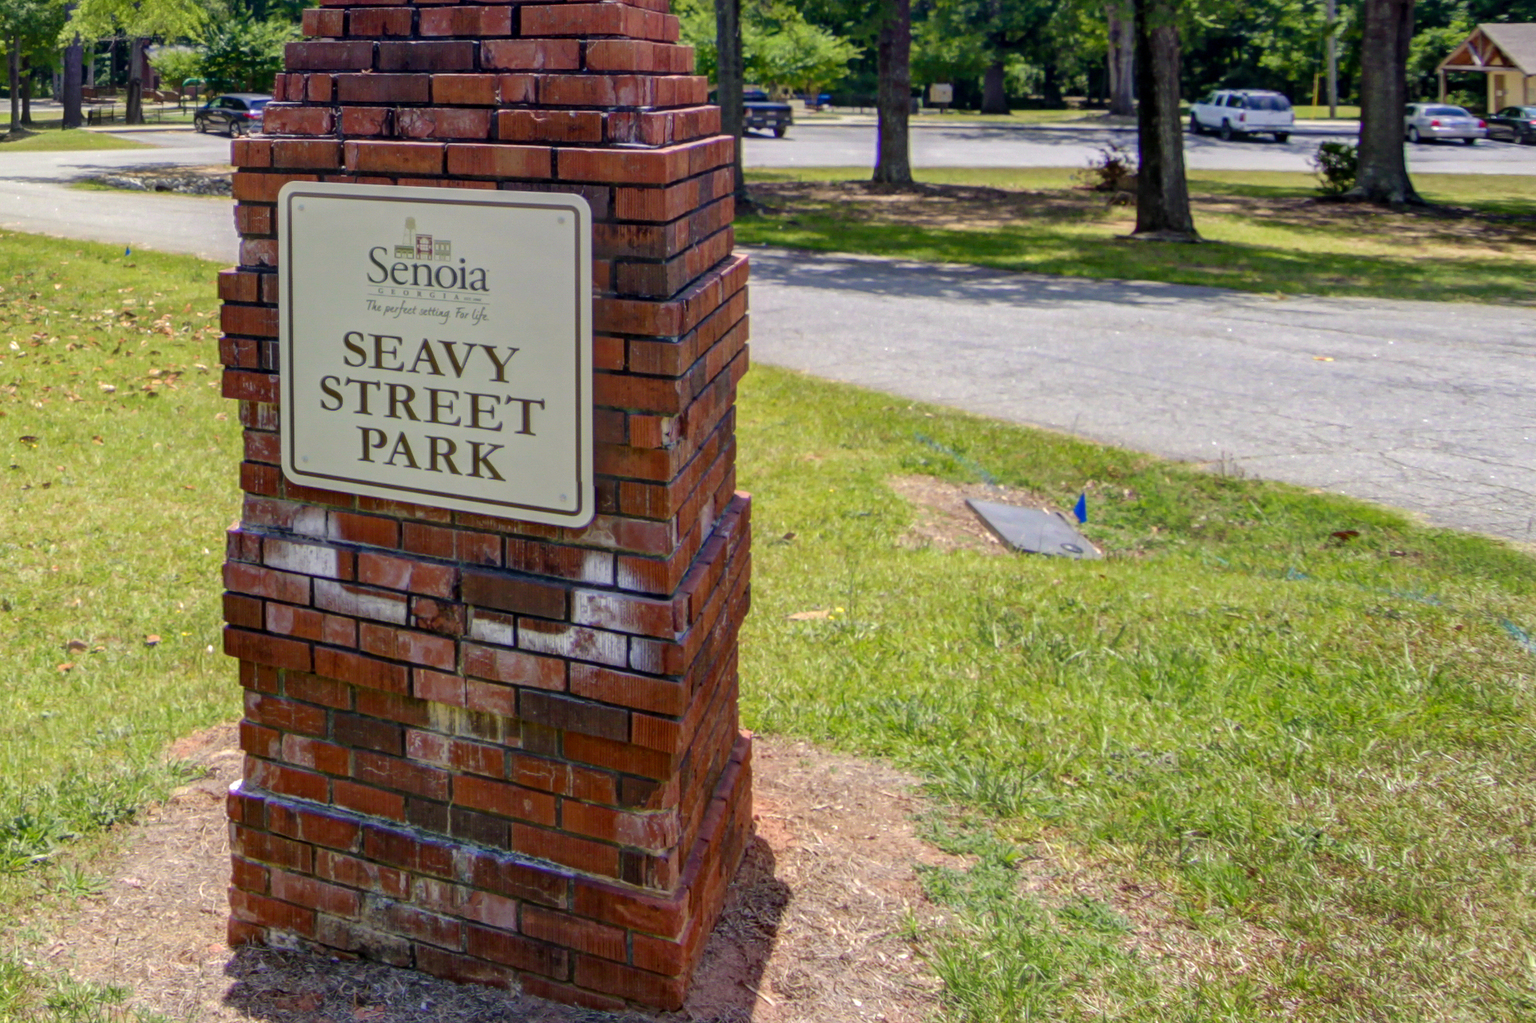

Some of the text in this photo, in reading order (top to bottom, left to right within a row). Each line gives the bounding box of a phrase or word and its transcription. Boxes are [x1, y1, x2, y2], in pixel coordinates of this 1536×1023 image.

[366, 246, 490, 292] Senoia
[365, 299, 382, 312] The
[382, 300, 417, 319] perfect
[455, 307, 469, 319] For
[377, 287, 460, 301] GEORGIA
[342, 331, 520, 384] SEAVY
[319, 375, 546, 437] STREET
[355, 425, 507, 482] PARK
